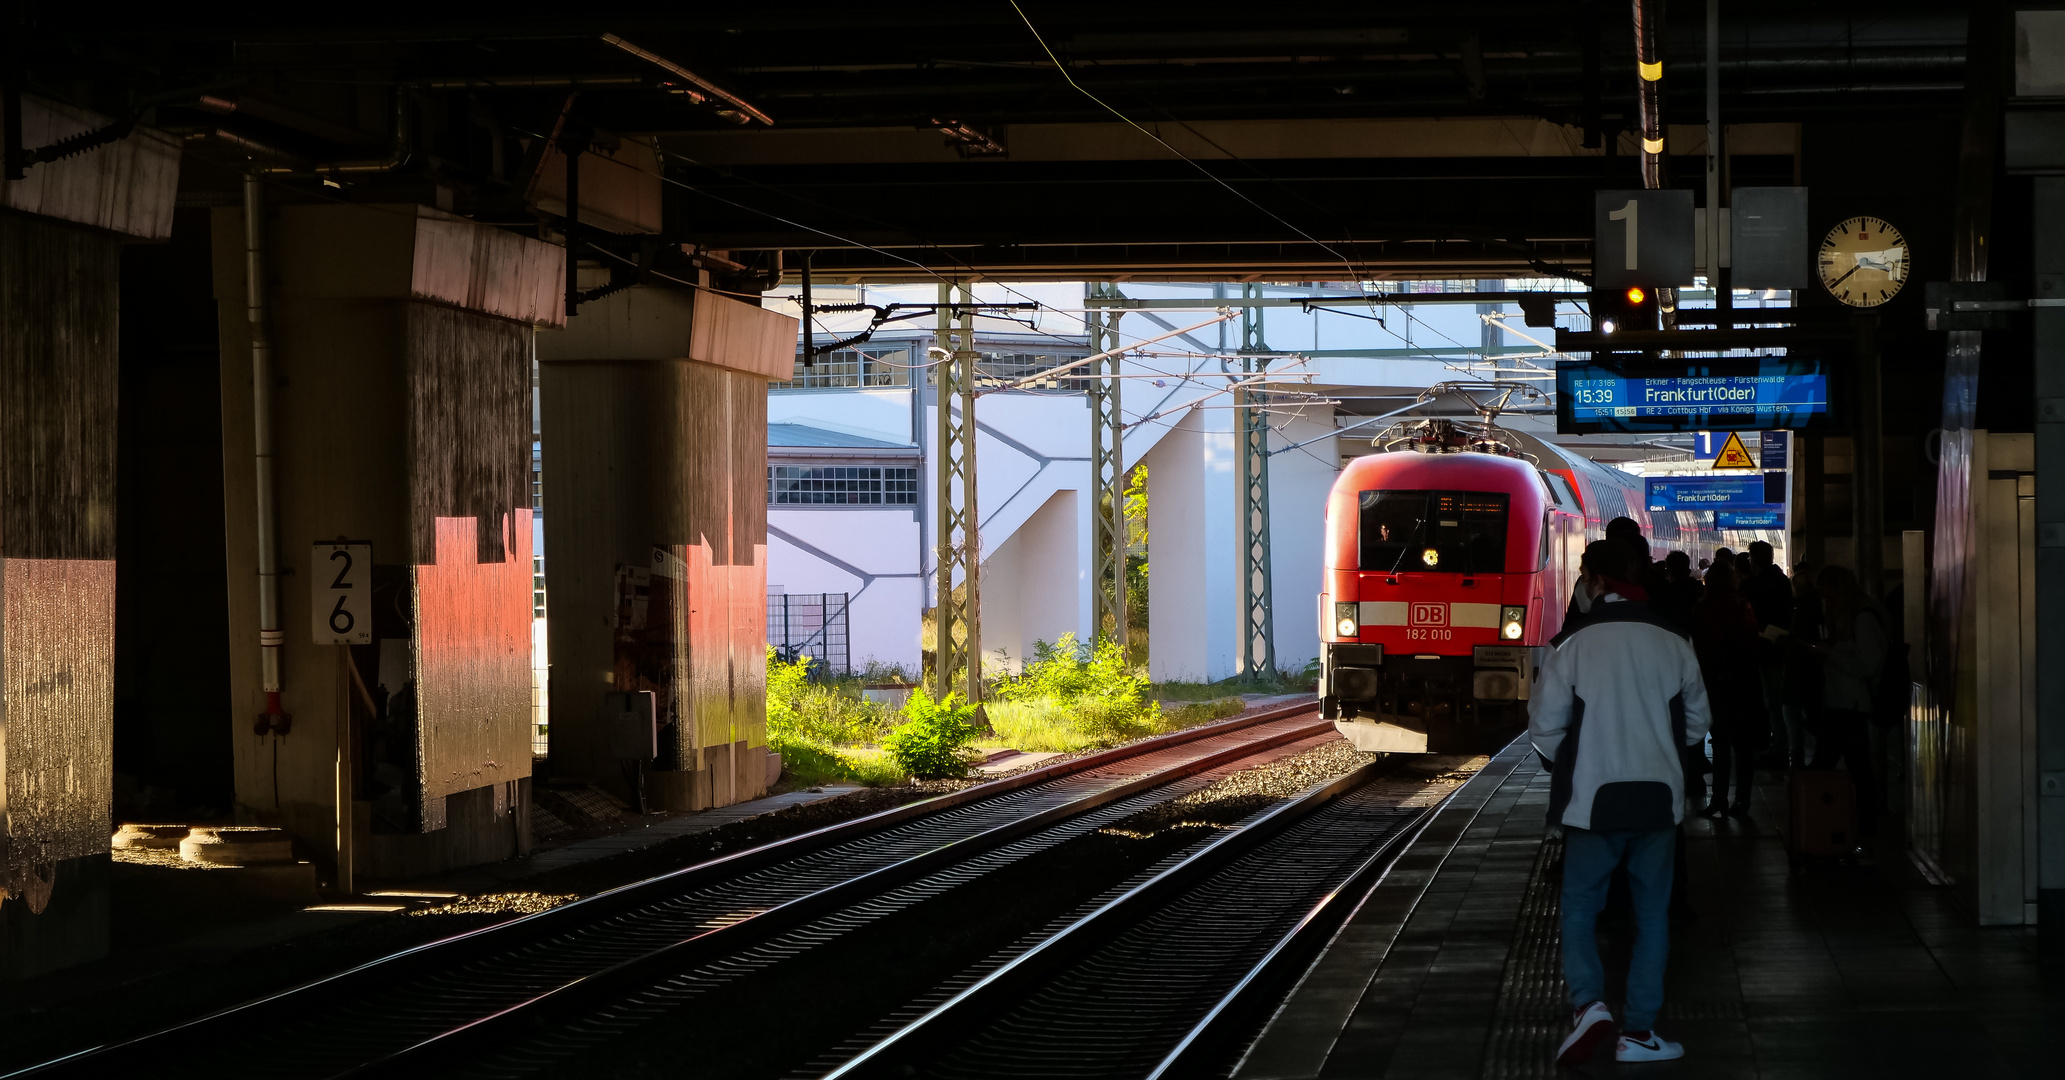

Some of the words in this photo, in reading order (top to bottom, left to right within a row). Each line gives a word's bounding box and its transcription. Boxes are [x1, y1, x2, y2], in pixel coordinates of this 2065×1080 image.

[1609, 199, 1638, 270] 1
[1646, 378, 1668, 386] Erkner
[1677, 377, 1727, 386] Fangschleuse
[1734, 376, 1785, 384] Fürstenwalde
[1575, 389, 1613, 404] 15:39
[1646, 386, 1755, 402] Frankfurt(Oder)
[1594, 408, 1613, 416] 15:51
[1646, 407, 1655, 415] RE
[1657, 407, 1662, 415] 2
[1699, 406, 1711, 414] Hbf
[1731, 405, 1754, 414] Königs
[1756, 405, 1790, 413] Wusterh.
[1698, 431, 1712, 454] 1
[1677, 494, 1730, 502] Frankfurt(Oder)
[329, 550, 353, 589] 2
[329, 595, 355, 634] 6
[1416, 607, 1442, 622] DB
[1406, 628, 1427, 640] 182
[1431, 629, 1452, 641] 010
